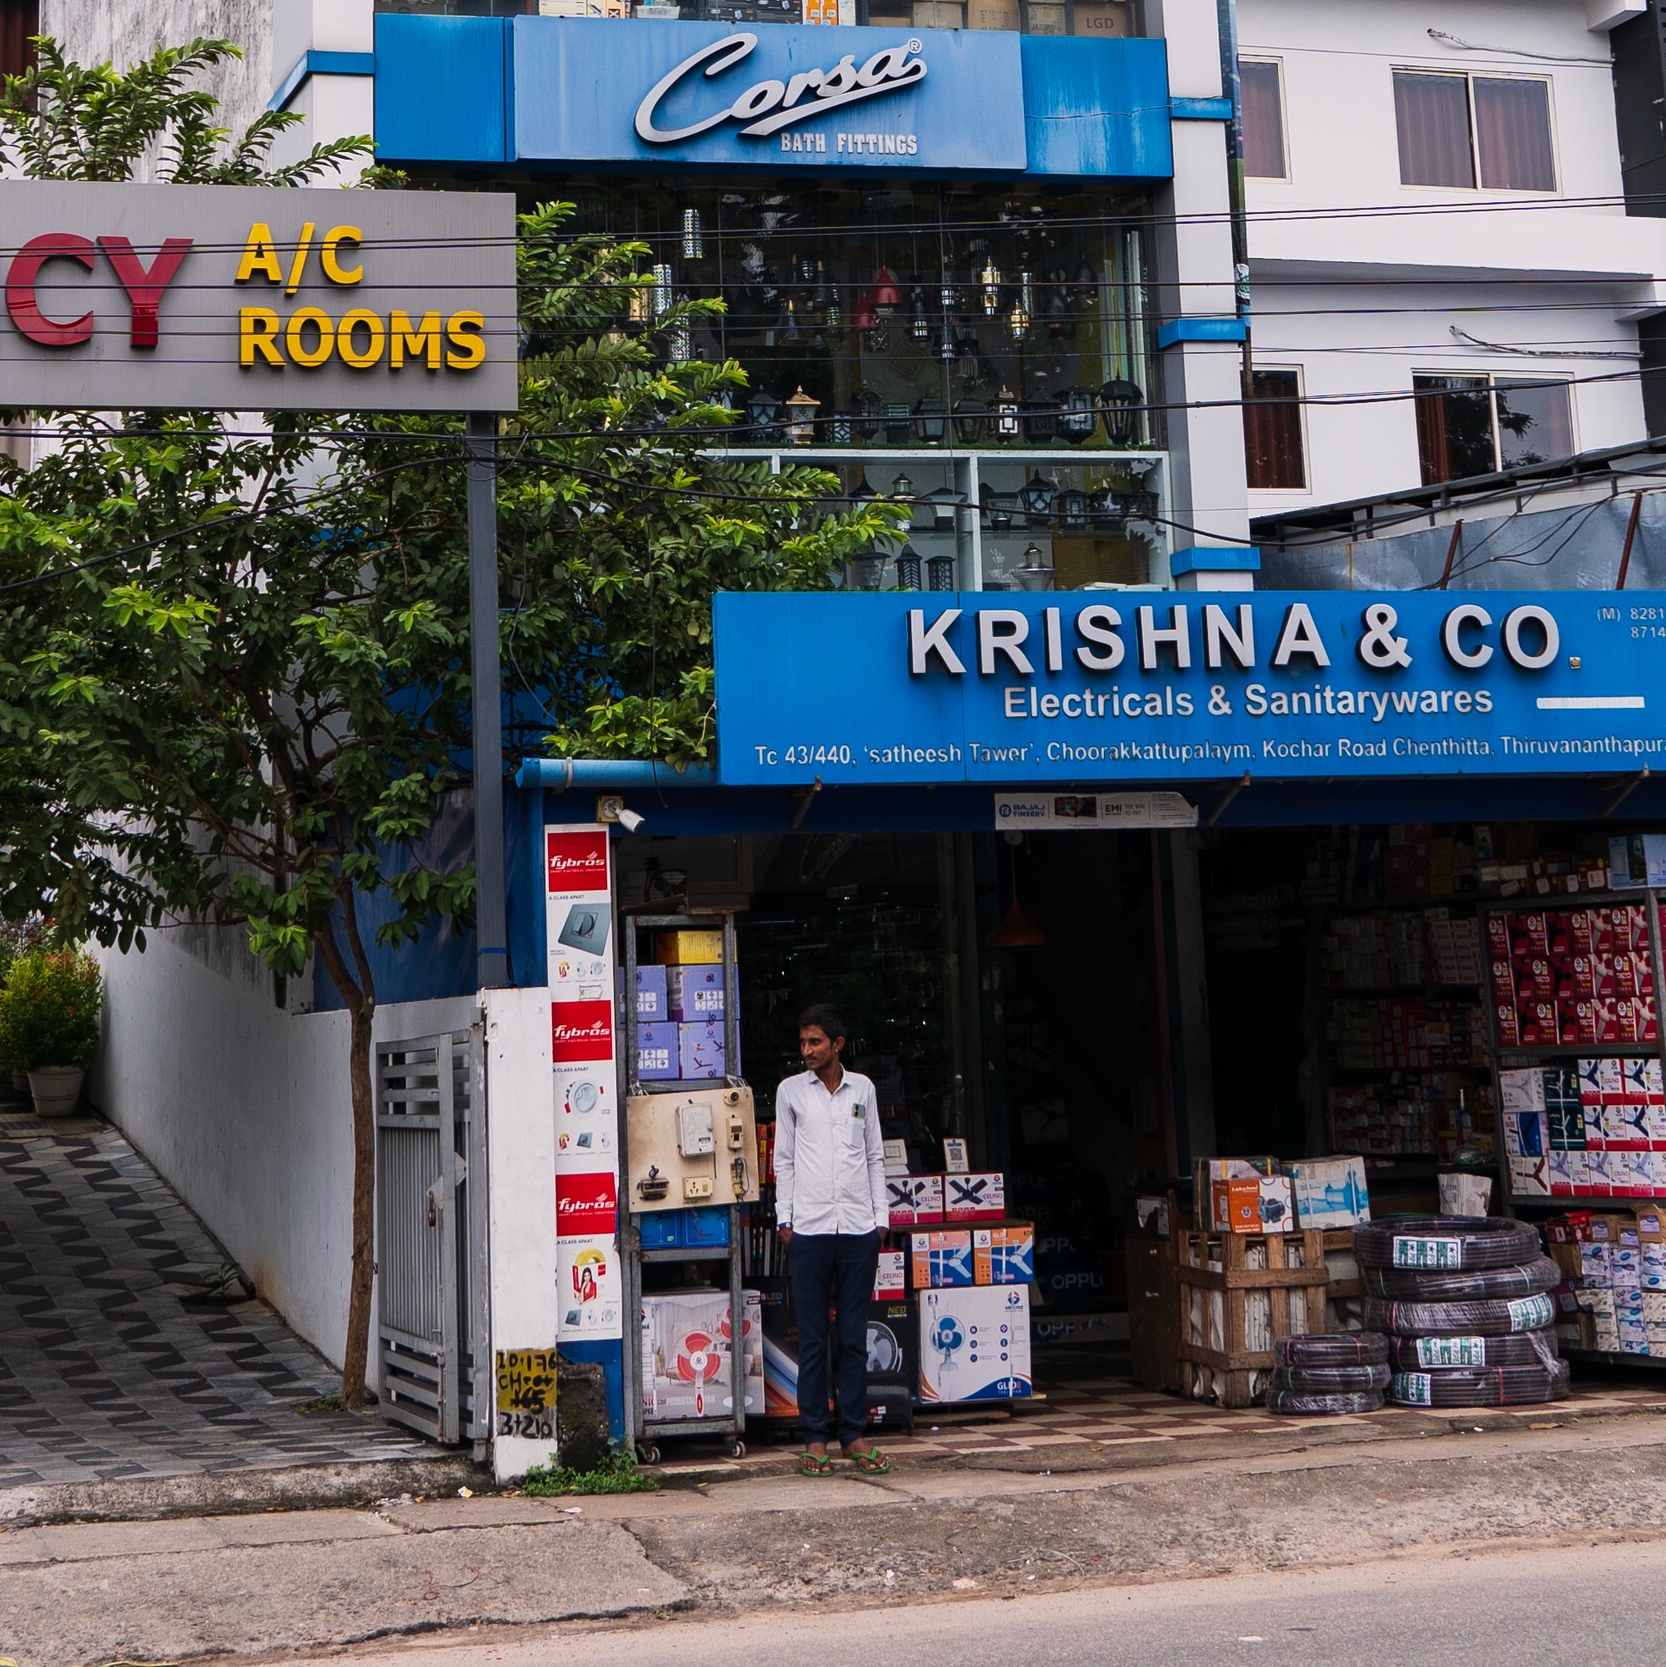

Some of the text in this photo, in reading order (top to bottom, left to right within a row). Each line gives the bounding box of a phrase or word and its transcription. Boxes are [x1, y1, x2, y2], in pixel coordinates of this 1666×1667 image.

[635, 32, 927, 142] Corsa
[781, 133, 918, 155] BATH FITTINGS
[234, 223, 364, 295] A/C
[239, 307, 487, 370] ROOMS
[1596, 607, 1621, 622] (M)
[906, 603, 1331, 675] KRISHNA
[1356, 603, 1413, 670] &
[1004, 683, 1493, 723] Electricals & Sanitarywares
[755, 745, 778, 766] Tc
[784, 743, 857, 768] 43/440,
[1263, 738, 1331, 759] Kochar
[1338, 738, 1386, 758] Road
[550, 851, 605, 870] fybros
[554, 1021, 610, 1040] fybros
[557, 1193, 615, 1212] fybros
